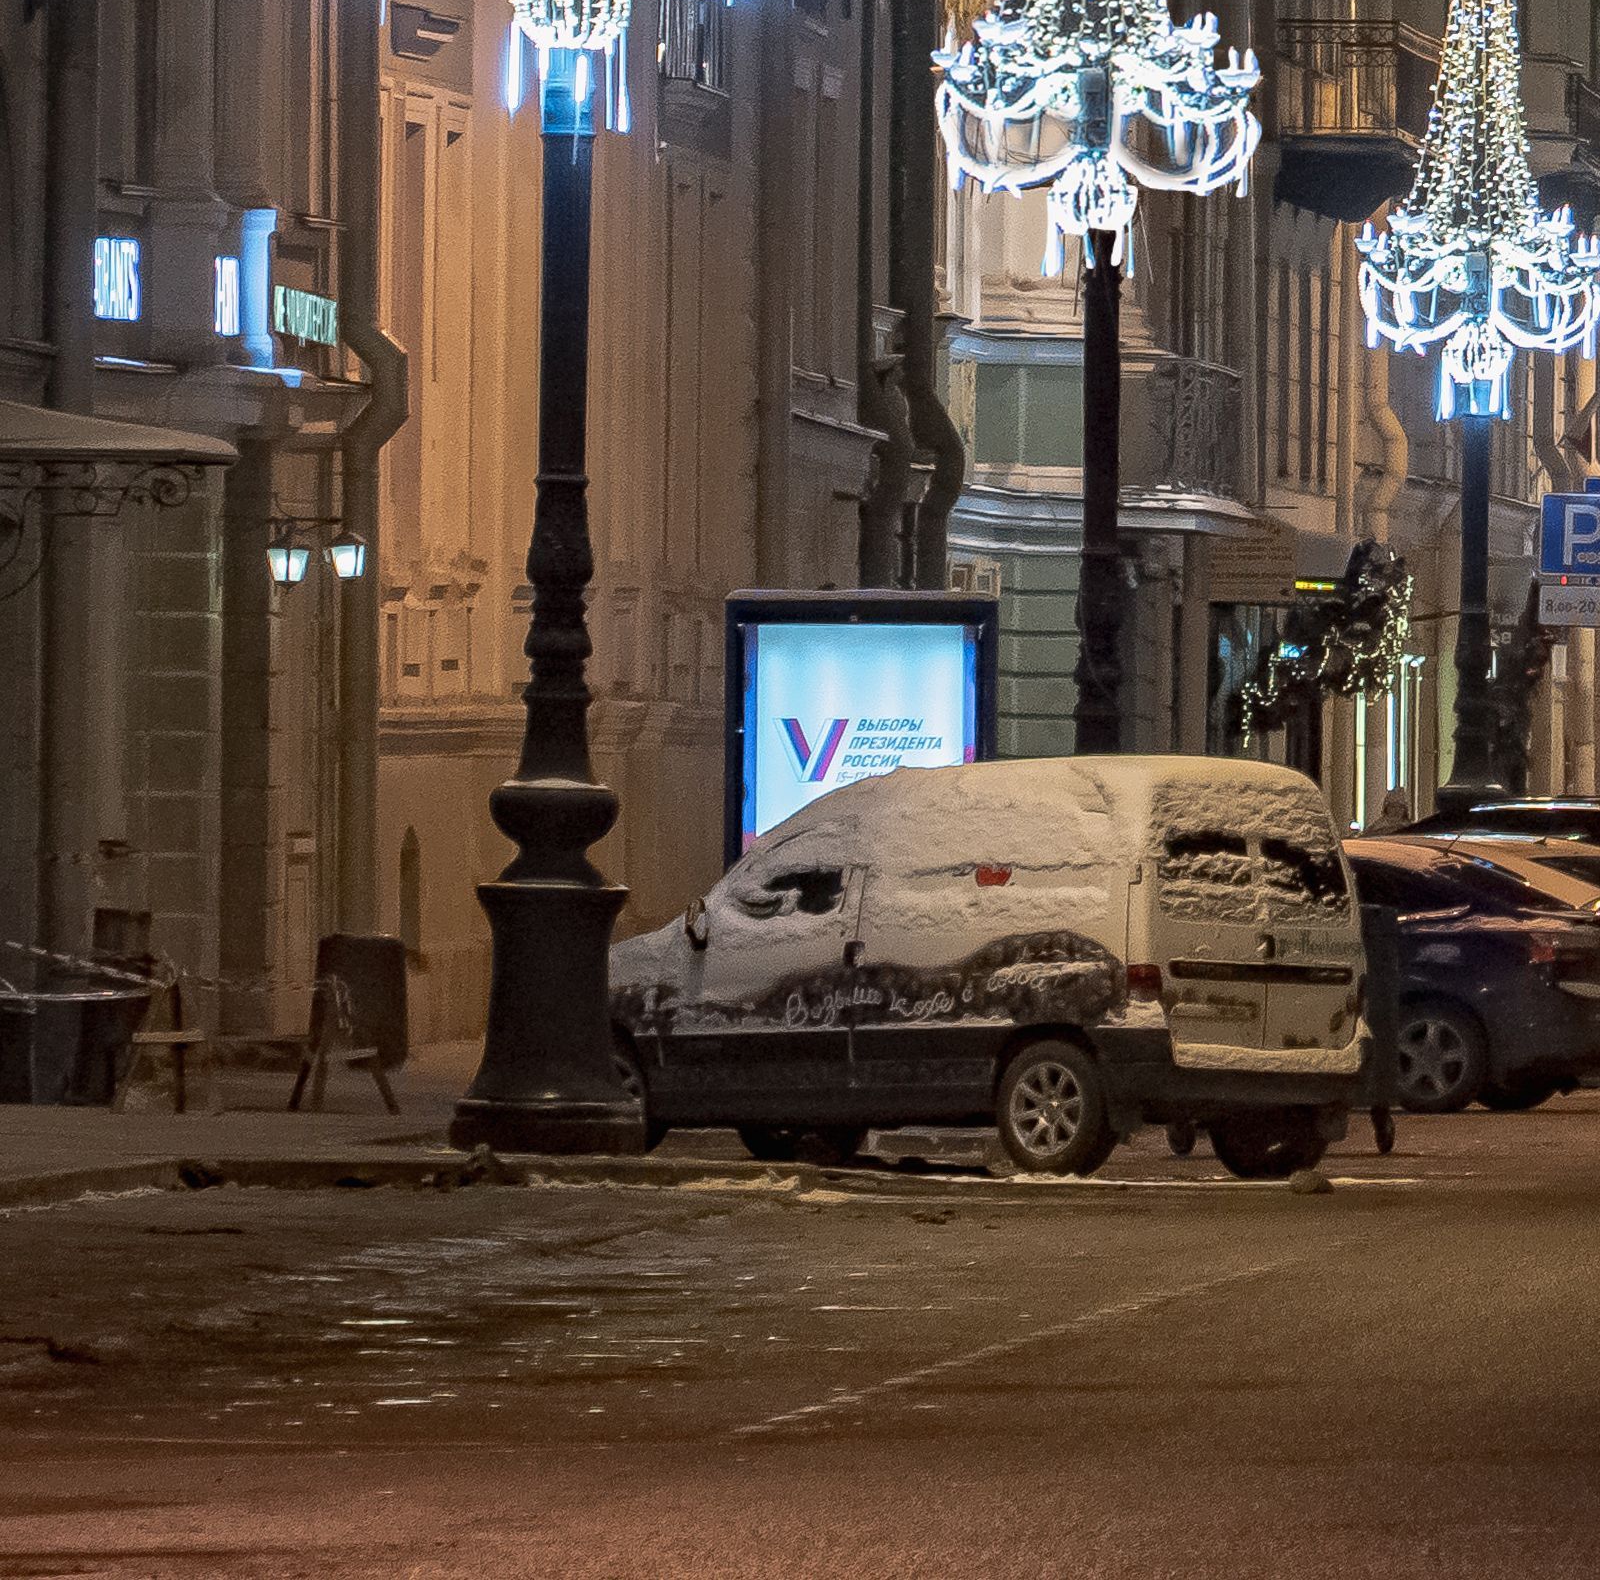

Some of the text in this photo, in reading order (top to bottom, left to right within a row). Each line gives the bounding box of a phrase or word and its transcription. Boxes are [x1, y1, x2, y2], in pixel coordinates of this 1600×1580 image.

[856, 719, 923, 732] ВЫБОРЫ
[848, 736, 942, 750] ПРЕЗИДЕНТА
[841, 754, 903, 768] РОССИИ
